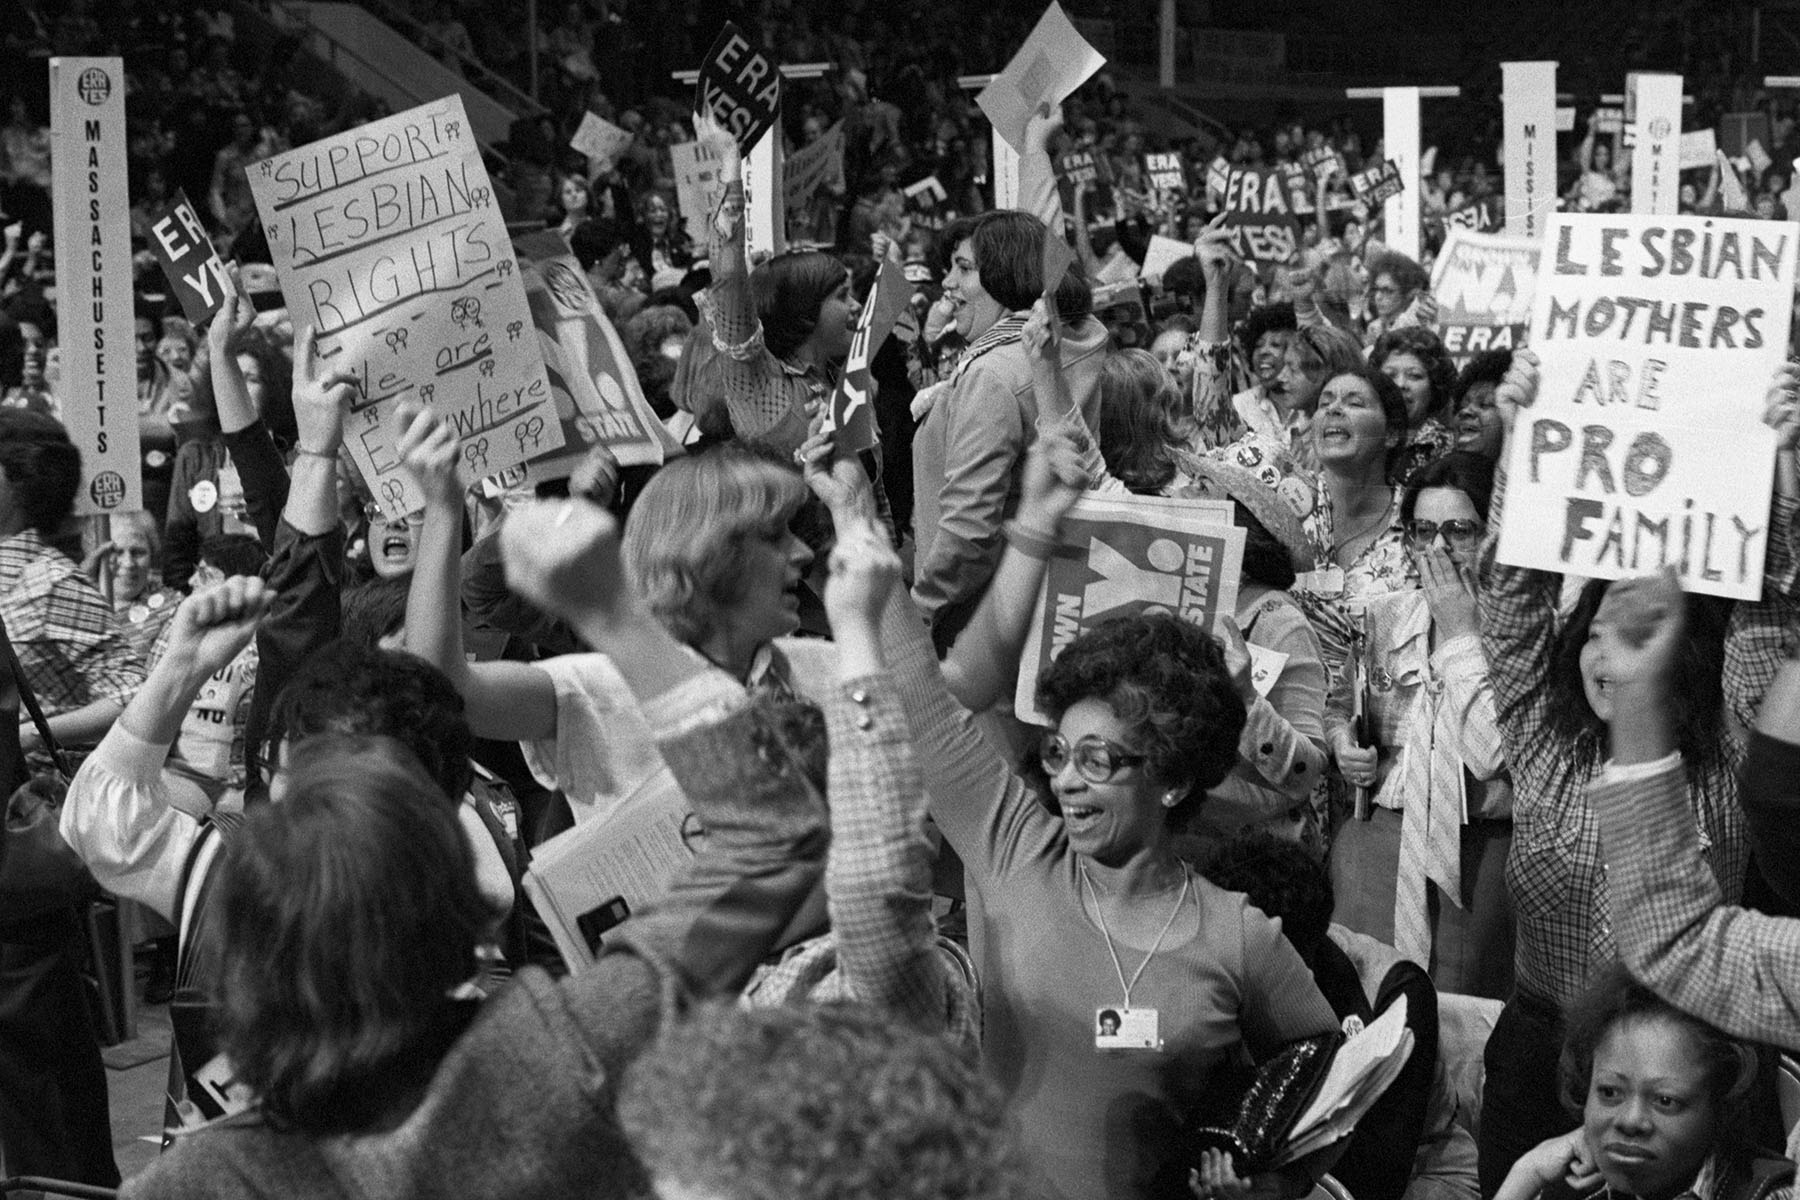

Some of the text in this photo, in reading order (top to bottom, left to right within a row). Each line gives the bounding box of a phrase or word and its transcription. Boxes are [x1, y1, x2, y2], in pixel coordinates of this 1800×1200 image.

[81, 88, 108, 104] YES
[83, 71, 107, 88] ERA
[716, 33, 780, 113] ERA
[274, 111, 449, 201] SUPPORT
[1146, 153, 1181, 169] ERA
[1351, 162, 1396, 193] ERA
[290, 161, 473, 260] LESBIAN
[1225, 170, 1288, 215] ERA
[152, 203, 206, 263] ER
[84, 119, 108, 454] MASSACHUSETTS
[308, 221, 492, 331] RIGHTS
[1444, 325, 1513, 351] ERA
[1545, 295, 1765, 349] MOTHERS
[436, 333, 494, 370] are
[1572, 357, 1668, 412] ARE
[94, 473, 121, 492] ERA
[1530, 418, 1673, 497] PRO
[92, 491, 122, 508] YES
[1179, 543, 1214, 628] STATE
